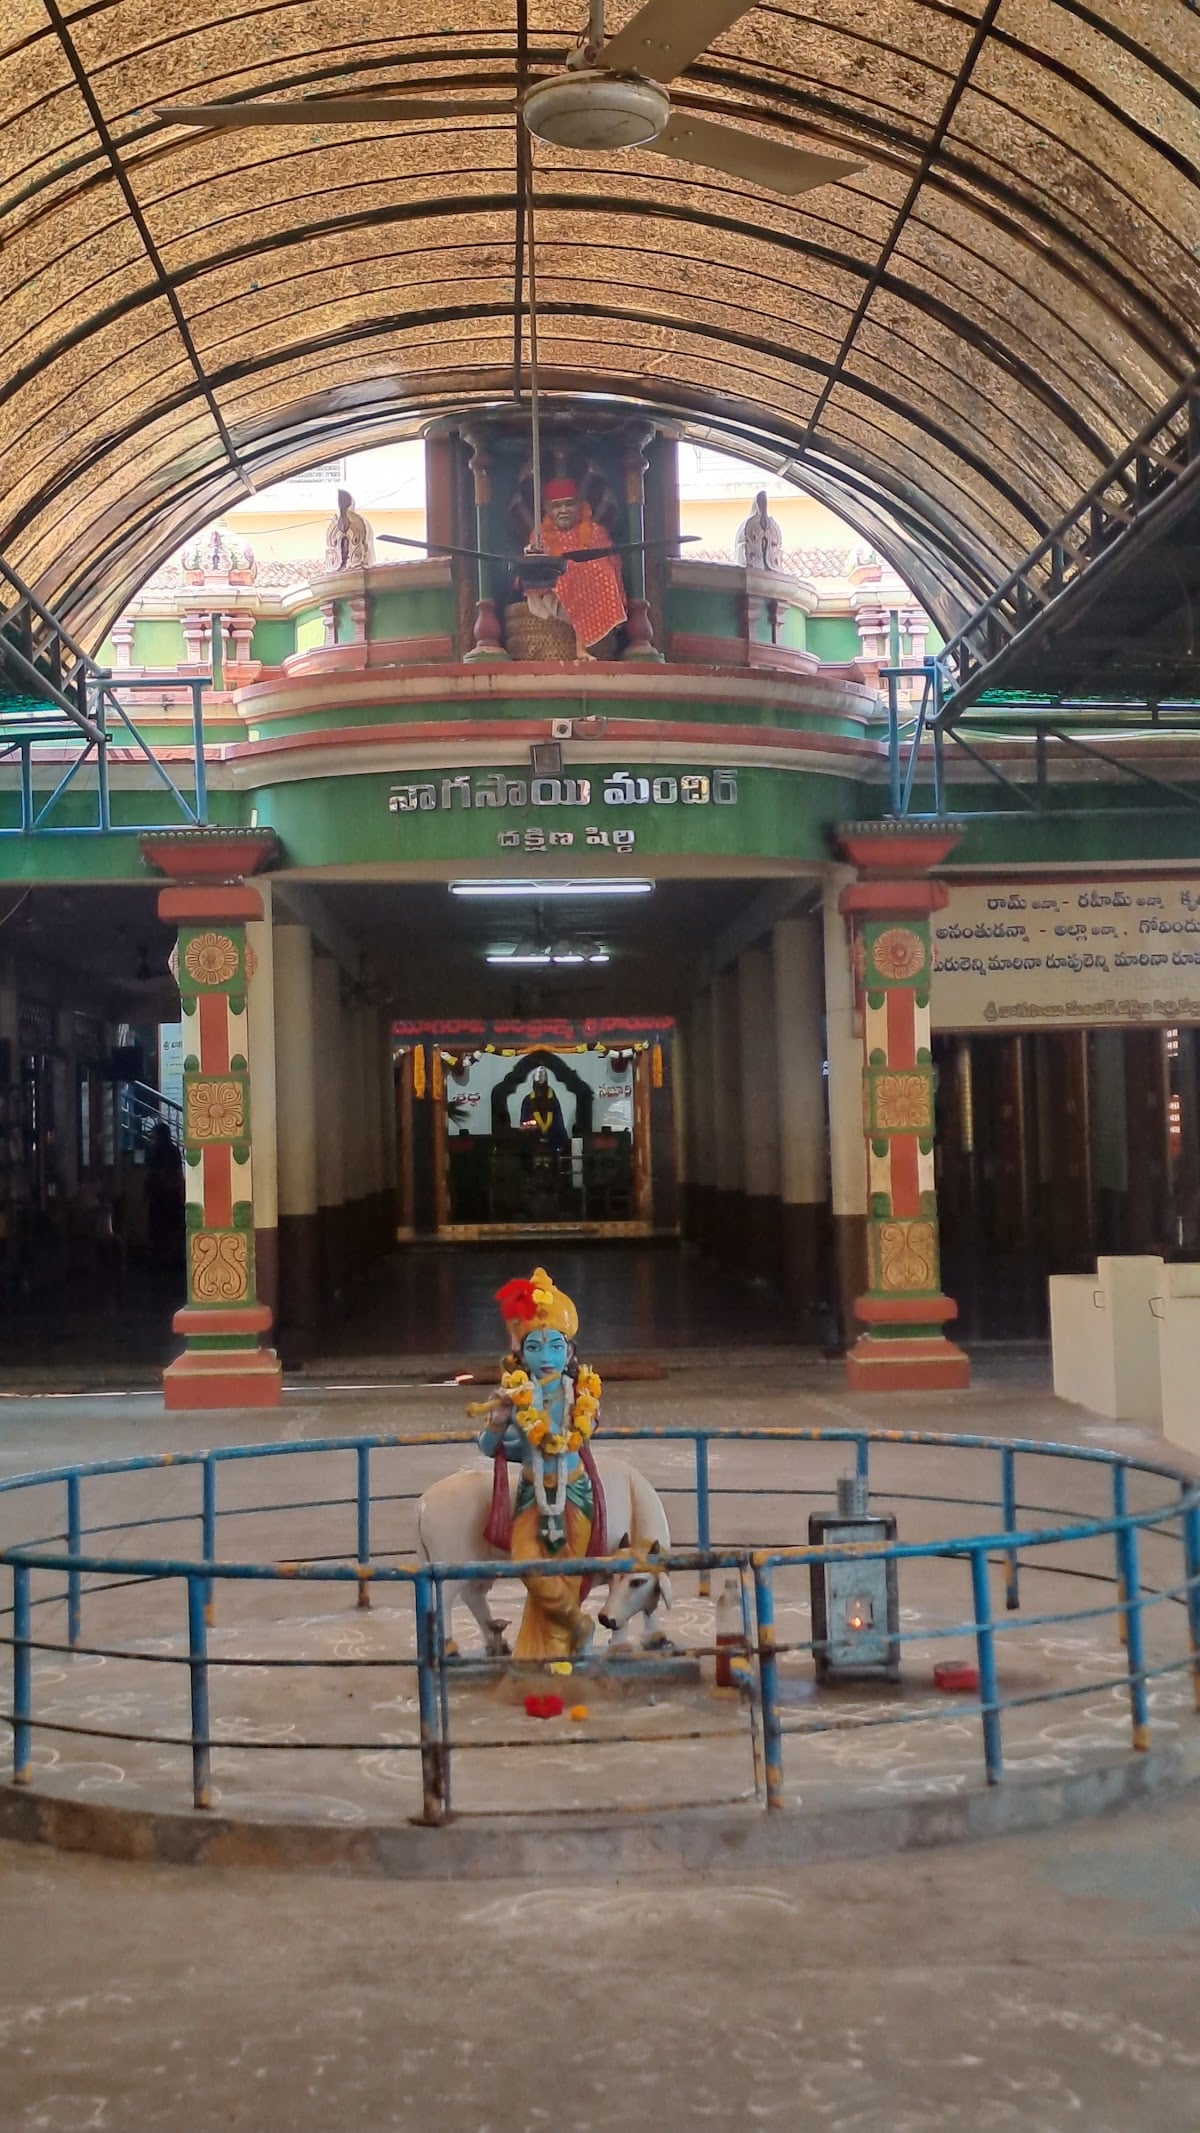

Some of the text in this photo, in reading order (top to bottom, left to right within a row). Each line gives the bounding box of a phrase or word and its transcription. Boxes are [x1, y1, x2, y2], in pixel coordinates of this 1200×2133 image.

[387, 769, 739, 812] నాగసాయి మందిర్
[497, 826, 636, 854] దక్షిణ షిర్డి
[986, 894, 1028, 910] రామ్
[988, 954, 1042, 972] మారినా
[1114, 951, 1169, 968] మారినా
